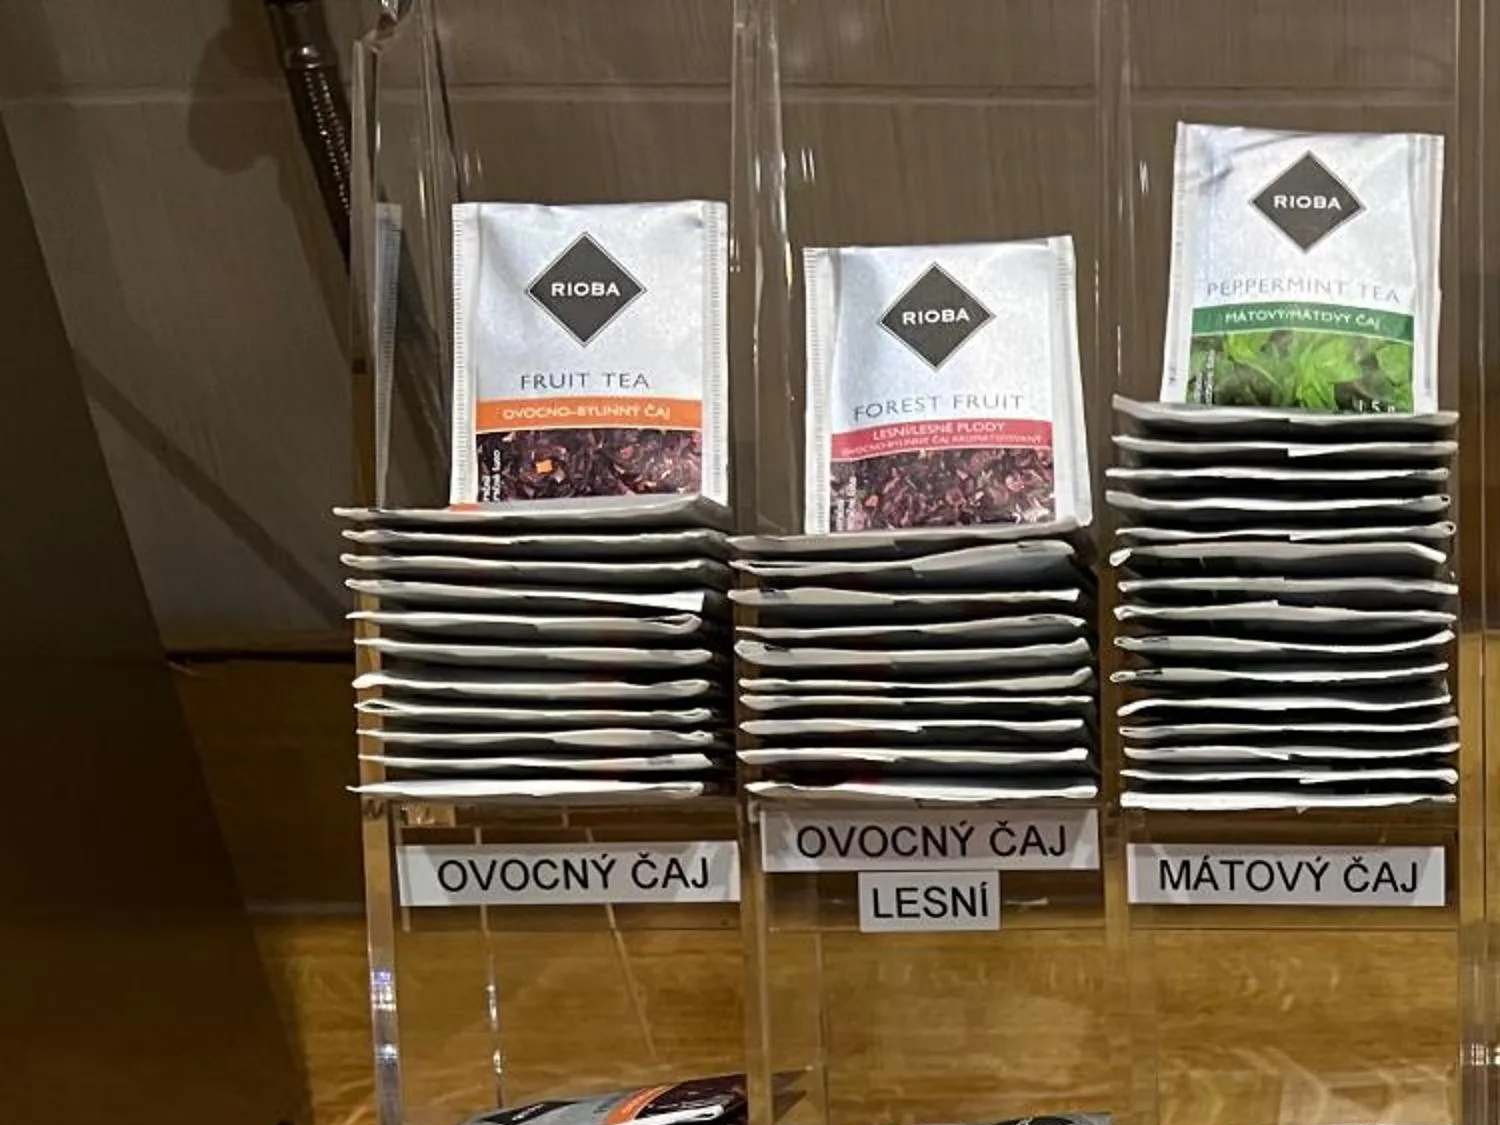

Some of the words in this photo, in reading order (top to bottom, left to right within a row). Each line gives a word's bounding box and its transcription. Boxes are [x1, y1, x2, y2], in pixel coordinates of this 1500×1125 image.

[1272, 194, 1343, 211] RIOBA
[550, 281, 622, 298] RIOBA
[1206, 277, 1347, 298] PEPPERMINT
[1358, 284, 1401, 305] TEA
[901, 306, 971, 326] RIOBA
[520, 371, 590, 390] FRUIT
[600, 372, 650, 389] TEA
[643, 403, 672, 420] ČAJ
[852, 395, 939, 423] FOREST
[952, 393, 1025, 411] FRUIT
[956, 420, 1006, 433] PLODY
[795, 819, 976, 859] OVOCNÝ
[988, 819, 1067, 858] ČAJ
[437, 853, 617, 893] OVOCNÝ
[630, 850, 710, 890] ČAJ
[1158, 854, 1331, 893] MÁTOVÝ
[1342, 856, 1418, 893] ČAJ
[871, 881, 989, 919] LESNÍ
